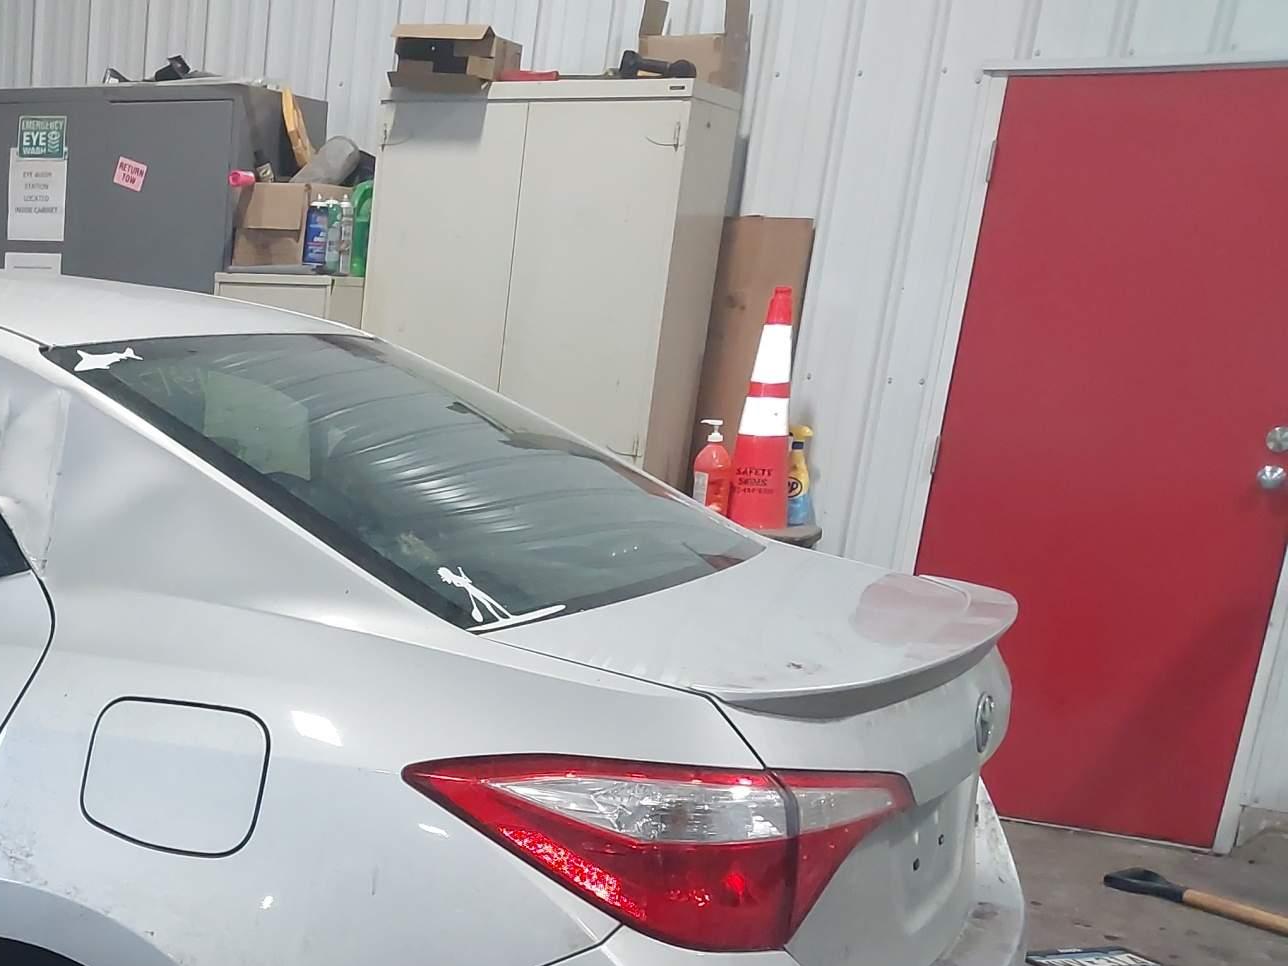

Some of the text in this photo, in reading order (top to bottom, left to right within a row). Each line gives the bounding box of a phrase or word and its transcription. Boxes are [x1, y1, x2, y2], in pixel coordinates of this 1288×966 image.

[23, 131, 46, 146] EYE
[119, 162, 144, 177] RETURN
[122, 172, 136, 185] TOW
[736, 467, 772, 476] SAFETY
